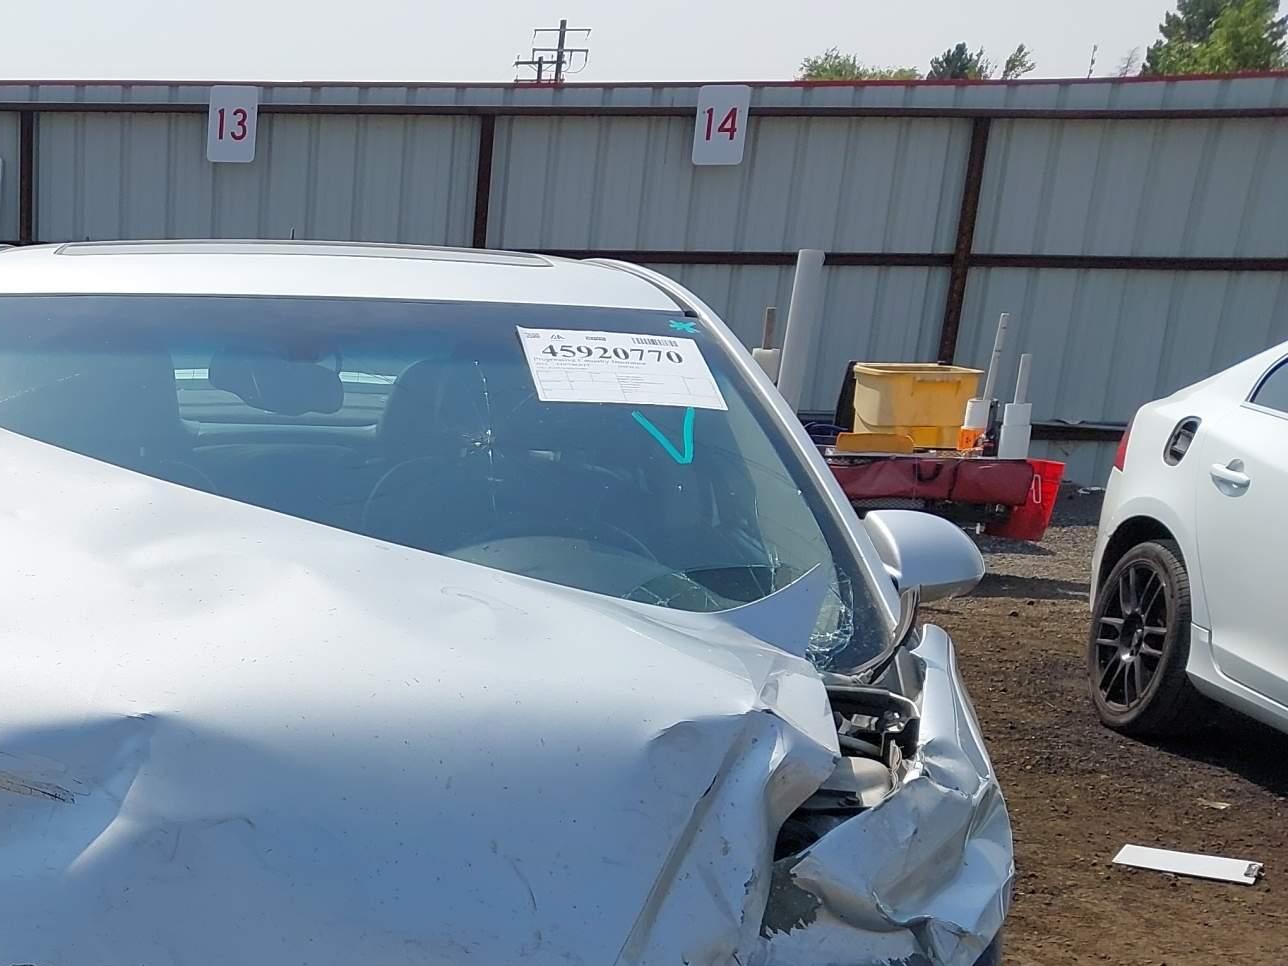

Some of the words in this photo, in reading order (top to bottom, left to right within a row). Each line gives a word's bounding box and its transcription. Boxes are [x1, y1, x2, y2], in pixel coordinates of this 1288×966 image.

[216, 107, 249, 142] 13
[704, 107, 738, 141] 14
[542, 343, 683, 364] 45920770
